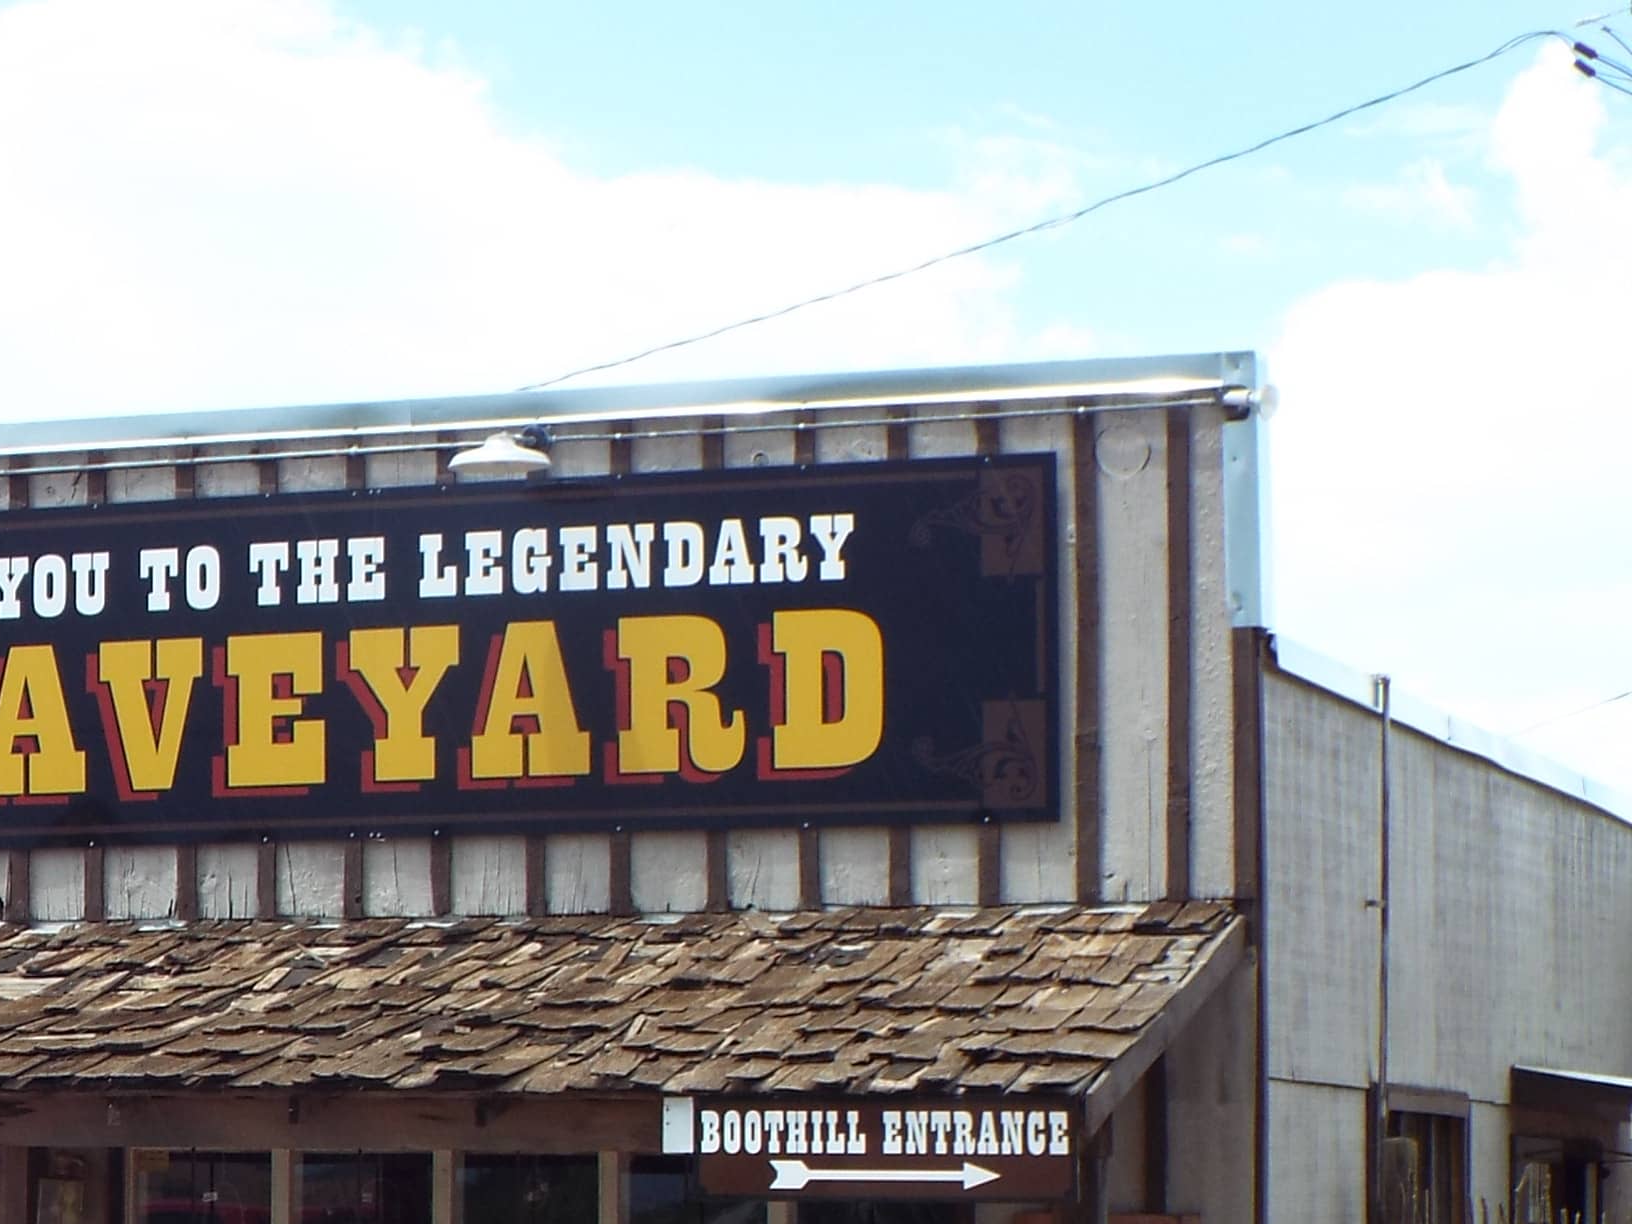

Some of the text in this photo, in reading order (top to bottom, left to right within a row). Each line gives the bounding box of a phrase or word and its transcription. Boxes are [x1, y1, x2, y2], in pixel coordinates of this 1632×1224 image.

[139, 545, 221, 612] TO
[249, 536, 386, 606] THE
[419, 513, 855, 598] LEGENDARY
[700, 1109, 1069, 1156] BOOTHILL ENTRANCE
